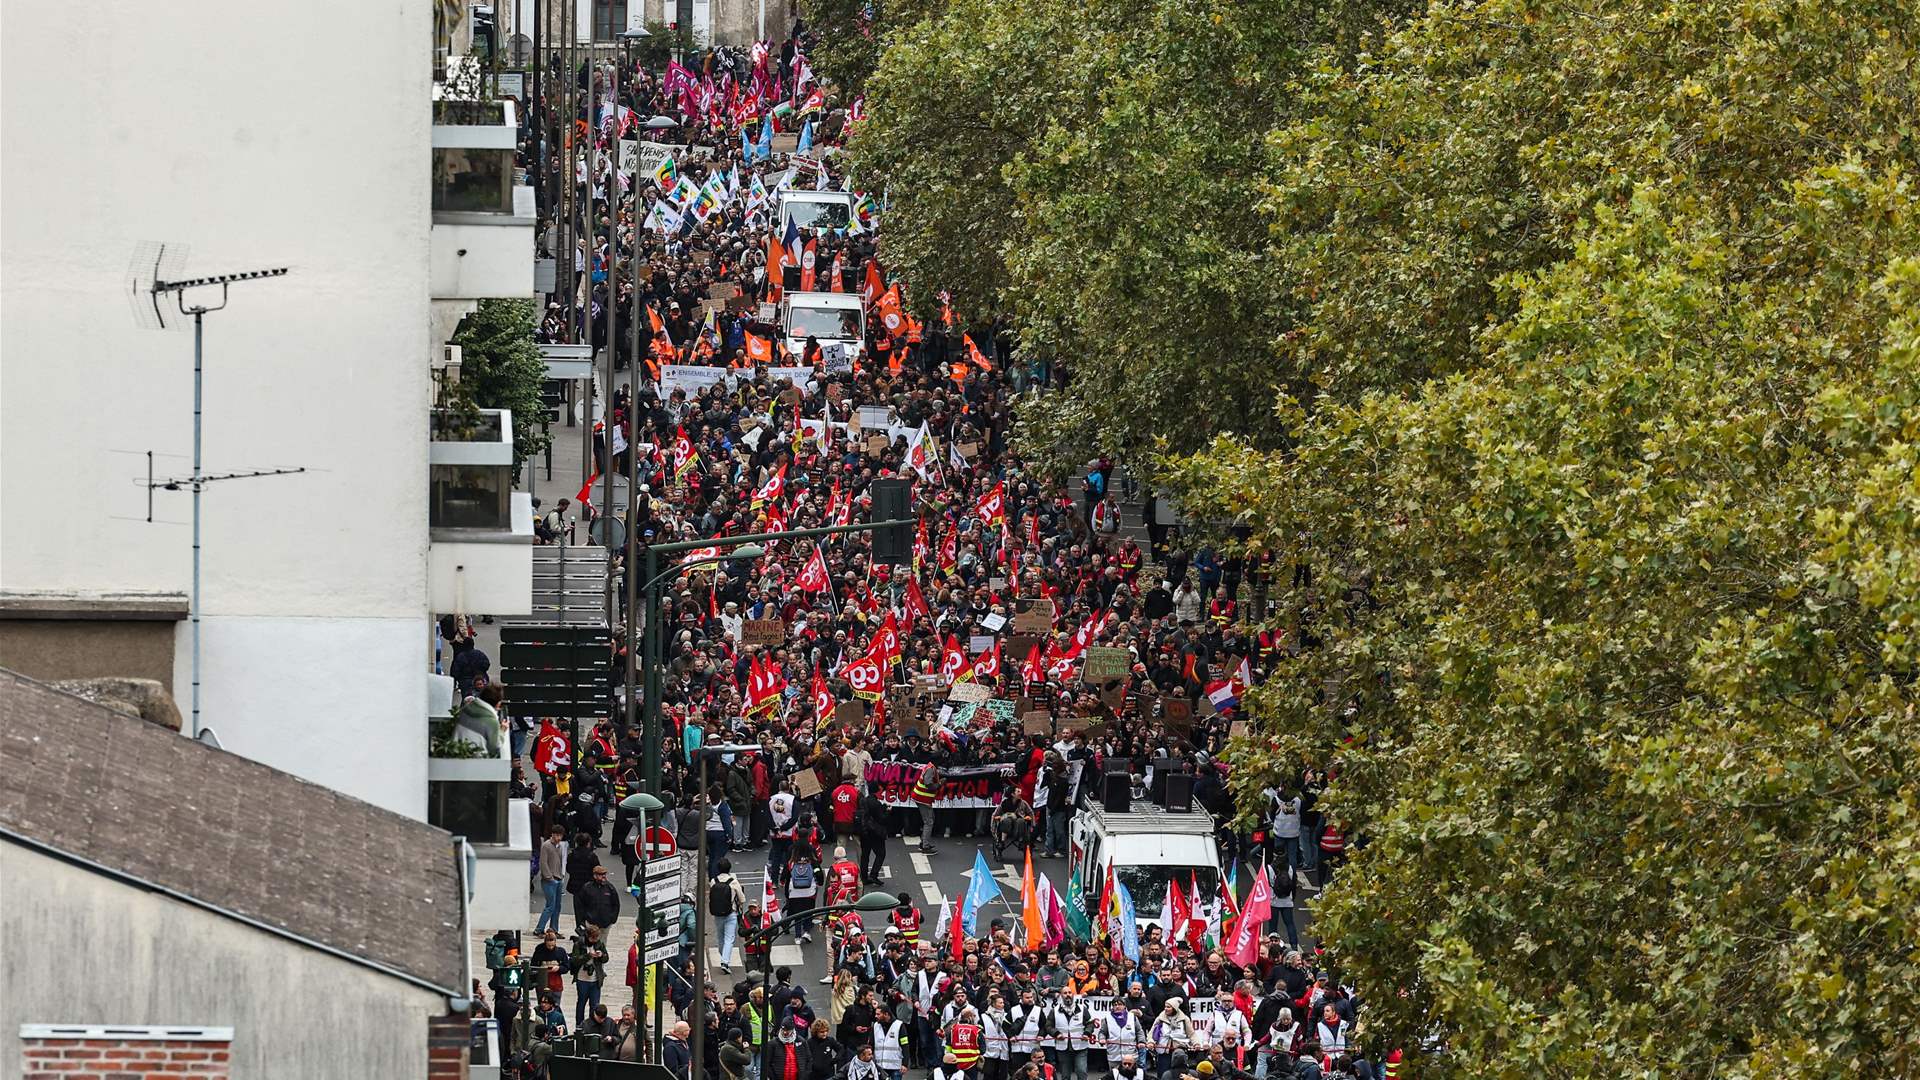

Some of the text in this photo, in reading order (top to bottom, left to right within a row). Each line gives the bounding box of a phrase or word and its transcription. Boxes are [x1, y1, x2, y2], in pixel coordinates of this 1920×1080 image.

[744, 620, 780, 632] MARINE
[901, 917, 914, 926] cgt
[659, 949, 670, 958] Jean
[670, 945, 679, 955] Zay
